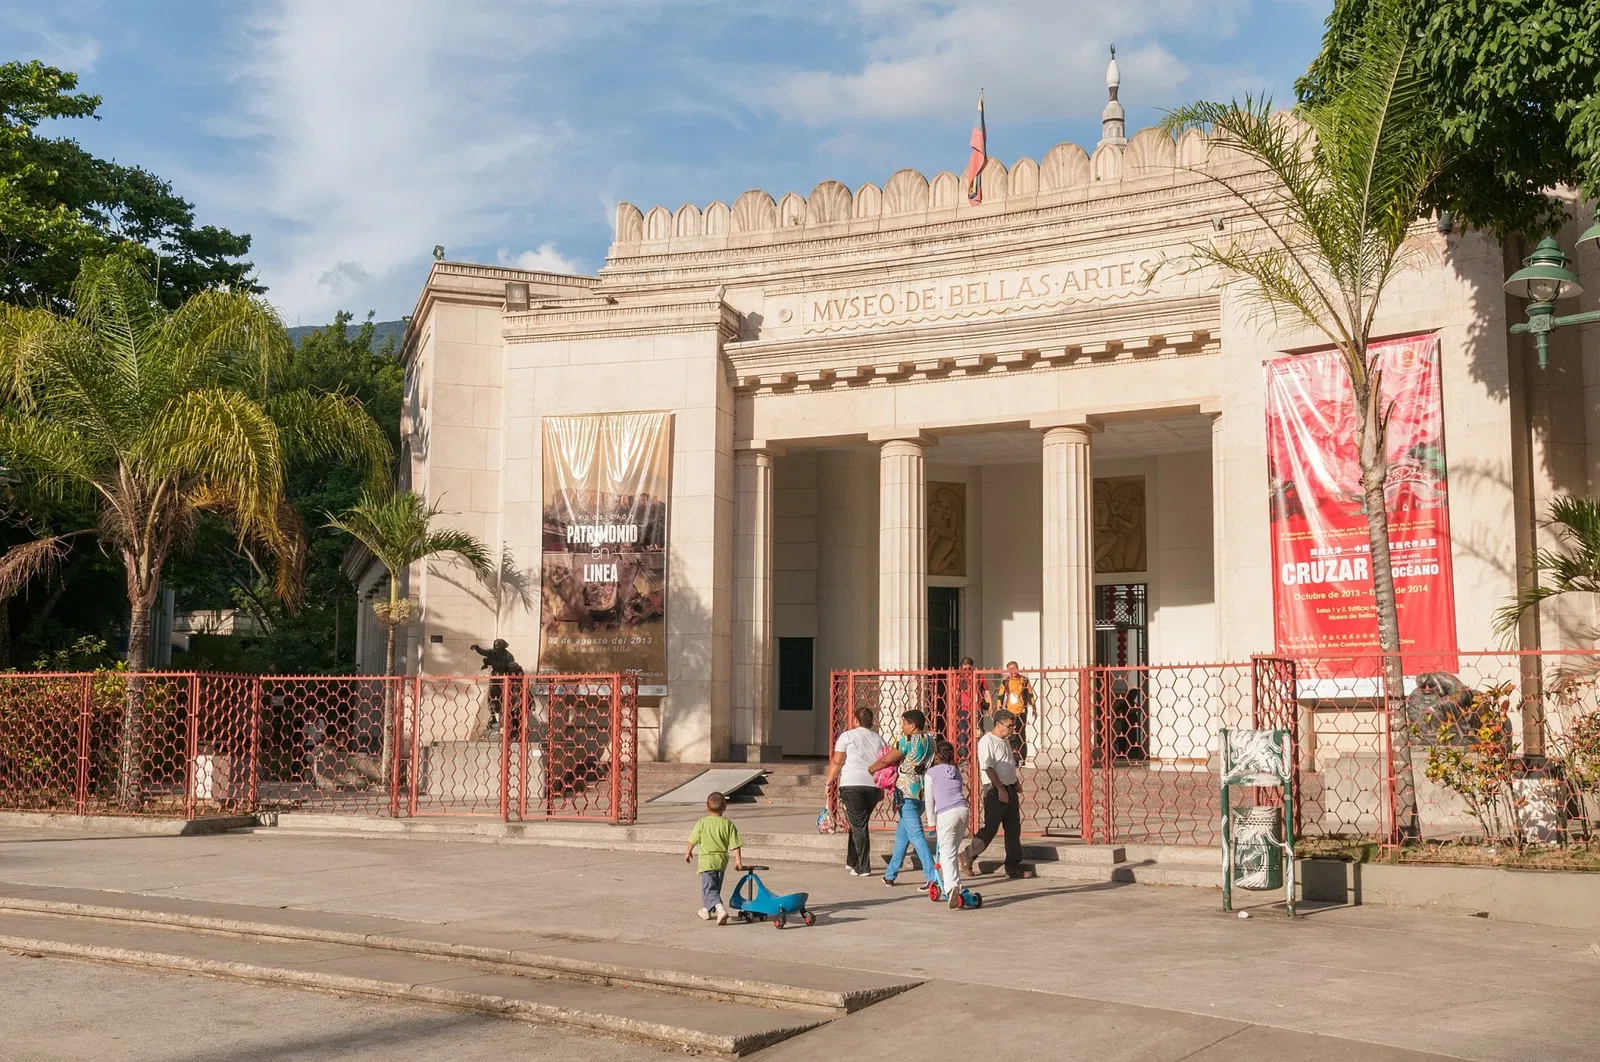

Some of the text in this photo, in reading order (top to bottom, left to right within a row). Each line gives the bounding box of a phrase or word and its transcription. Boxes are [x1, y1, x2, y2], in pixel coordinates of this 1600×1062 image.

[811, 259, 1152, 323] MVSEO DE BELLAS ARTES
[566, 524, 638, 544] PATRIMONIO
[591, 547, 610, 560] en
[583, 563, 619, 582] LINEA
[1281, 557, 1439, 586] CRUZAR OCÉANO
[1293, 590, 1326, 601] Octubre
[1328, 590, 1339, 599] de
[1341, 588, 1361, 598] 2013
[1395, 586, 1406, 594] de
[1408, 584, 1429, 593] 2014
[548, 637, 558, 645] 02
[575, 637, 607, 646] agosto
[611, 636, 627, 644] del
[630, 636, 653, 645] 2013
